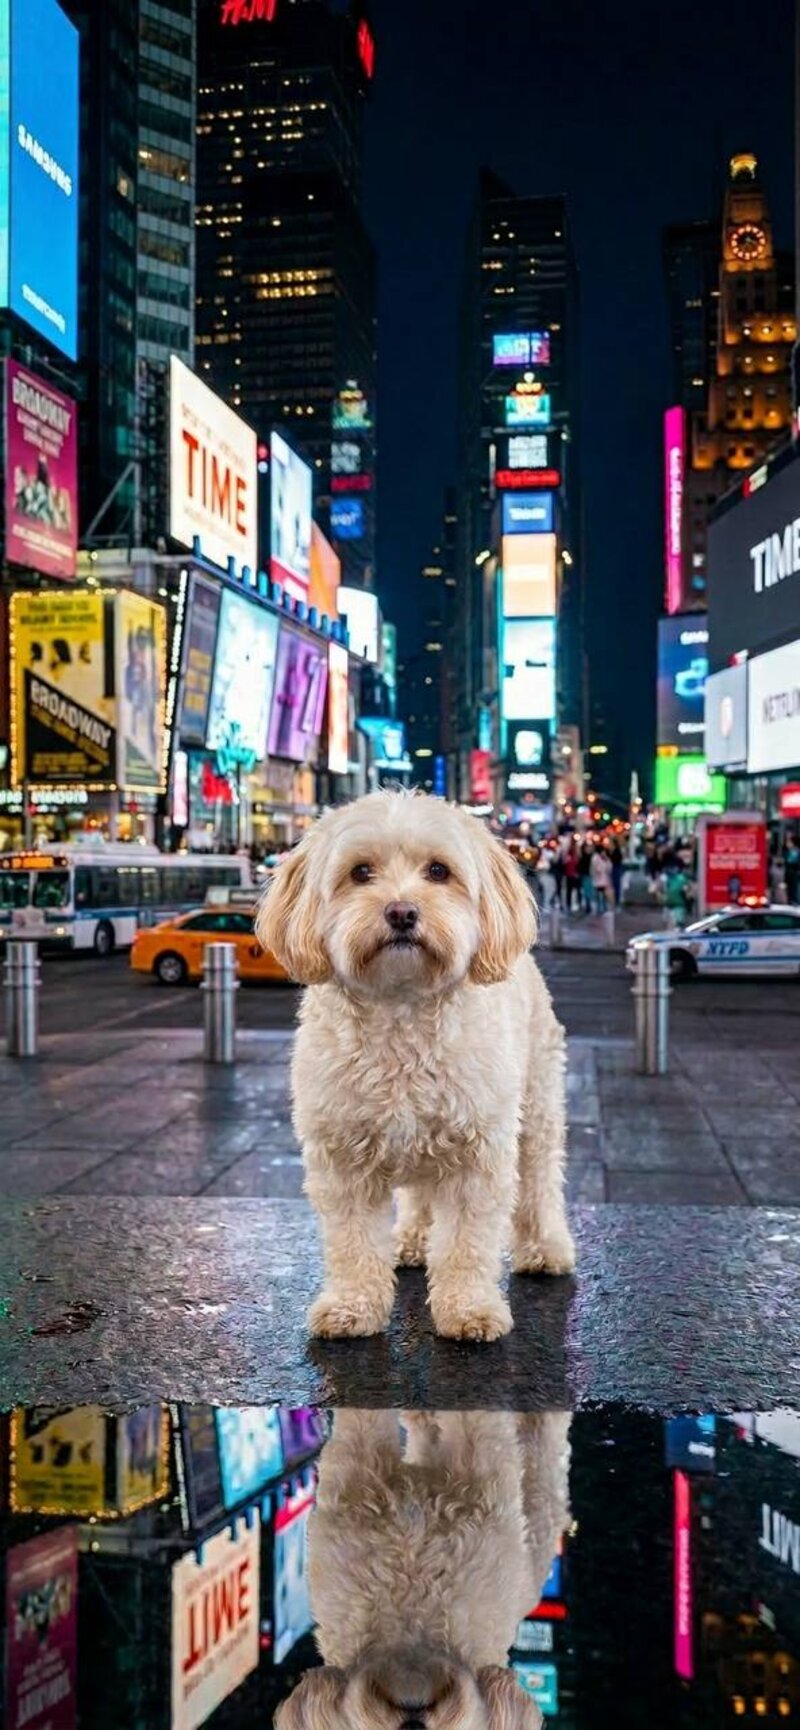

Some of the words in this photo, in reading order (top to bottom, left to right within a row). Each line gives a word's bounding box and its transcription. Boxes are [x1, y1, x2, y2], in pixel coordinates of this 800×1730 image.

[18, 124, 72, 197] SAMSUNG
[12, 376, 72, 437] BROADWAY
[182, 418, 247, 536] TIME
[31, 679, 111, 749] BROADWAY
